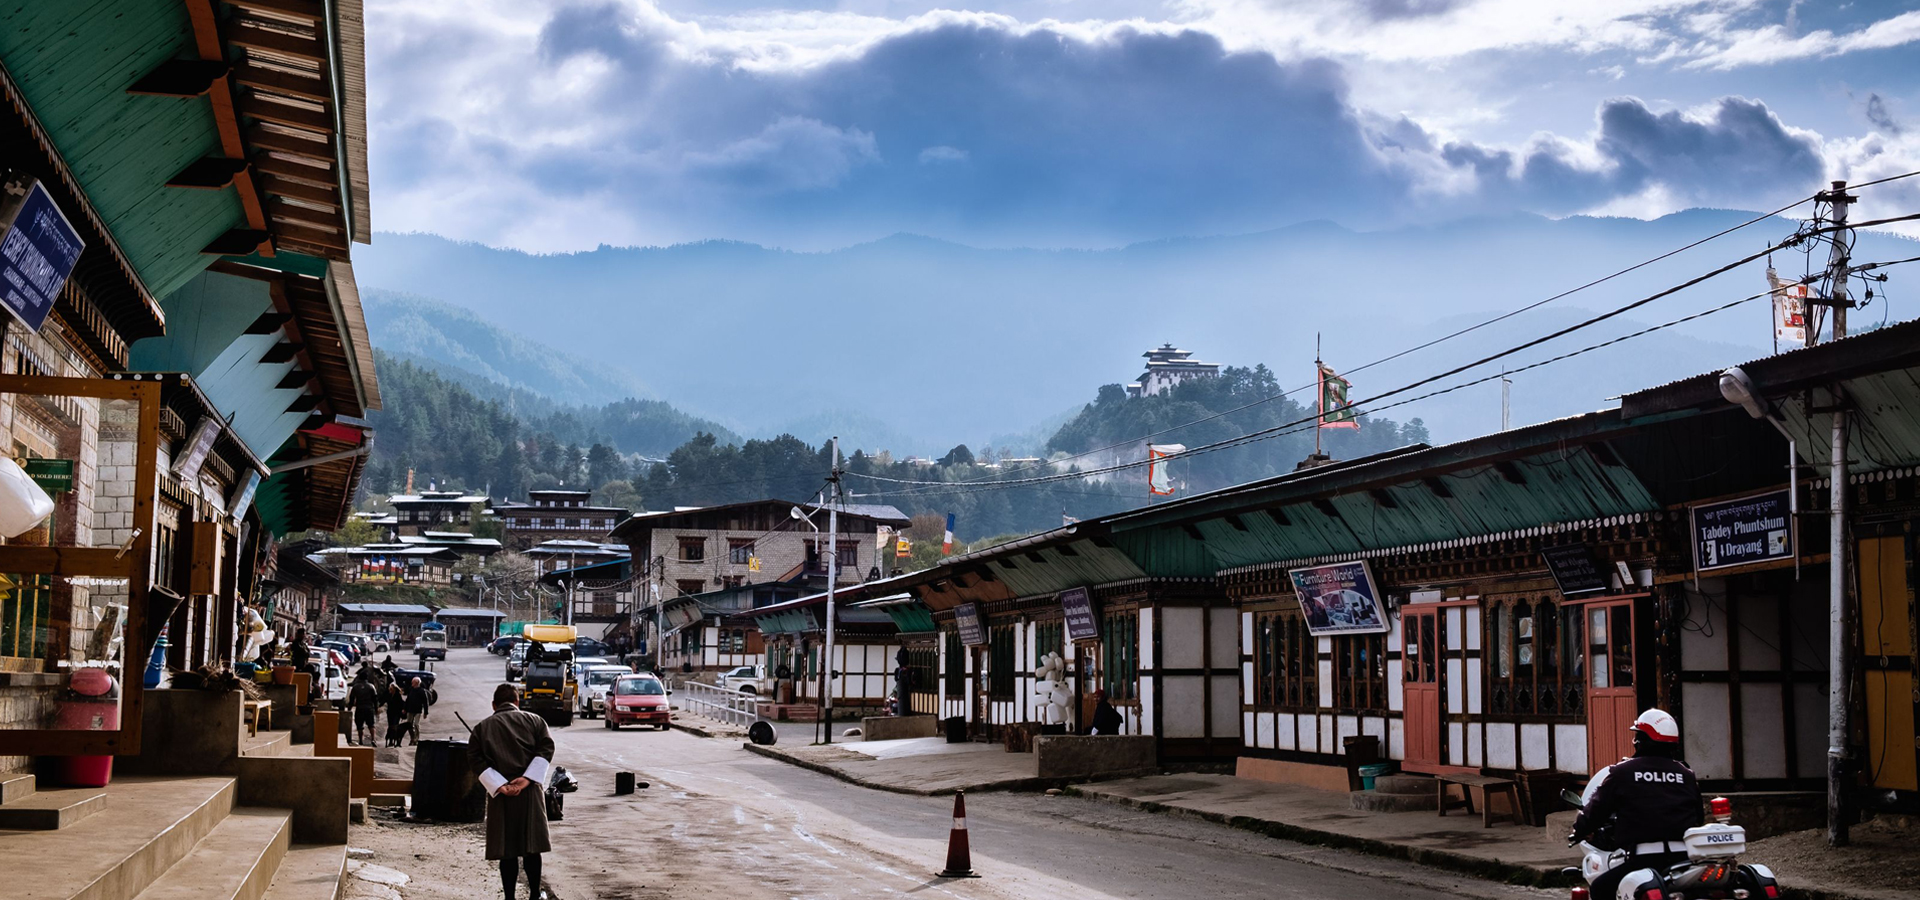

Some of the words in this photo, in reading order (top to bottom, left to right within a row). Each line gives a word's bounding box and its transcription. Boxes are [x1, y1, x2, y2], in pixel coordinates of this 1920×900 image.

[1702, 524, 1732, 540] Tabdey
[1734, 516, 1785, 535] Phuntshum
[1726, 538, 1763, 557] Drayang
[1299, 572, 1332, 585] Furniture
[1331, 568, 1354, 582] World
[1634, 771, 1684, 783] POLICE
[1707, 834, 1734, 843] POLICE
